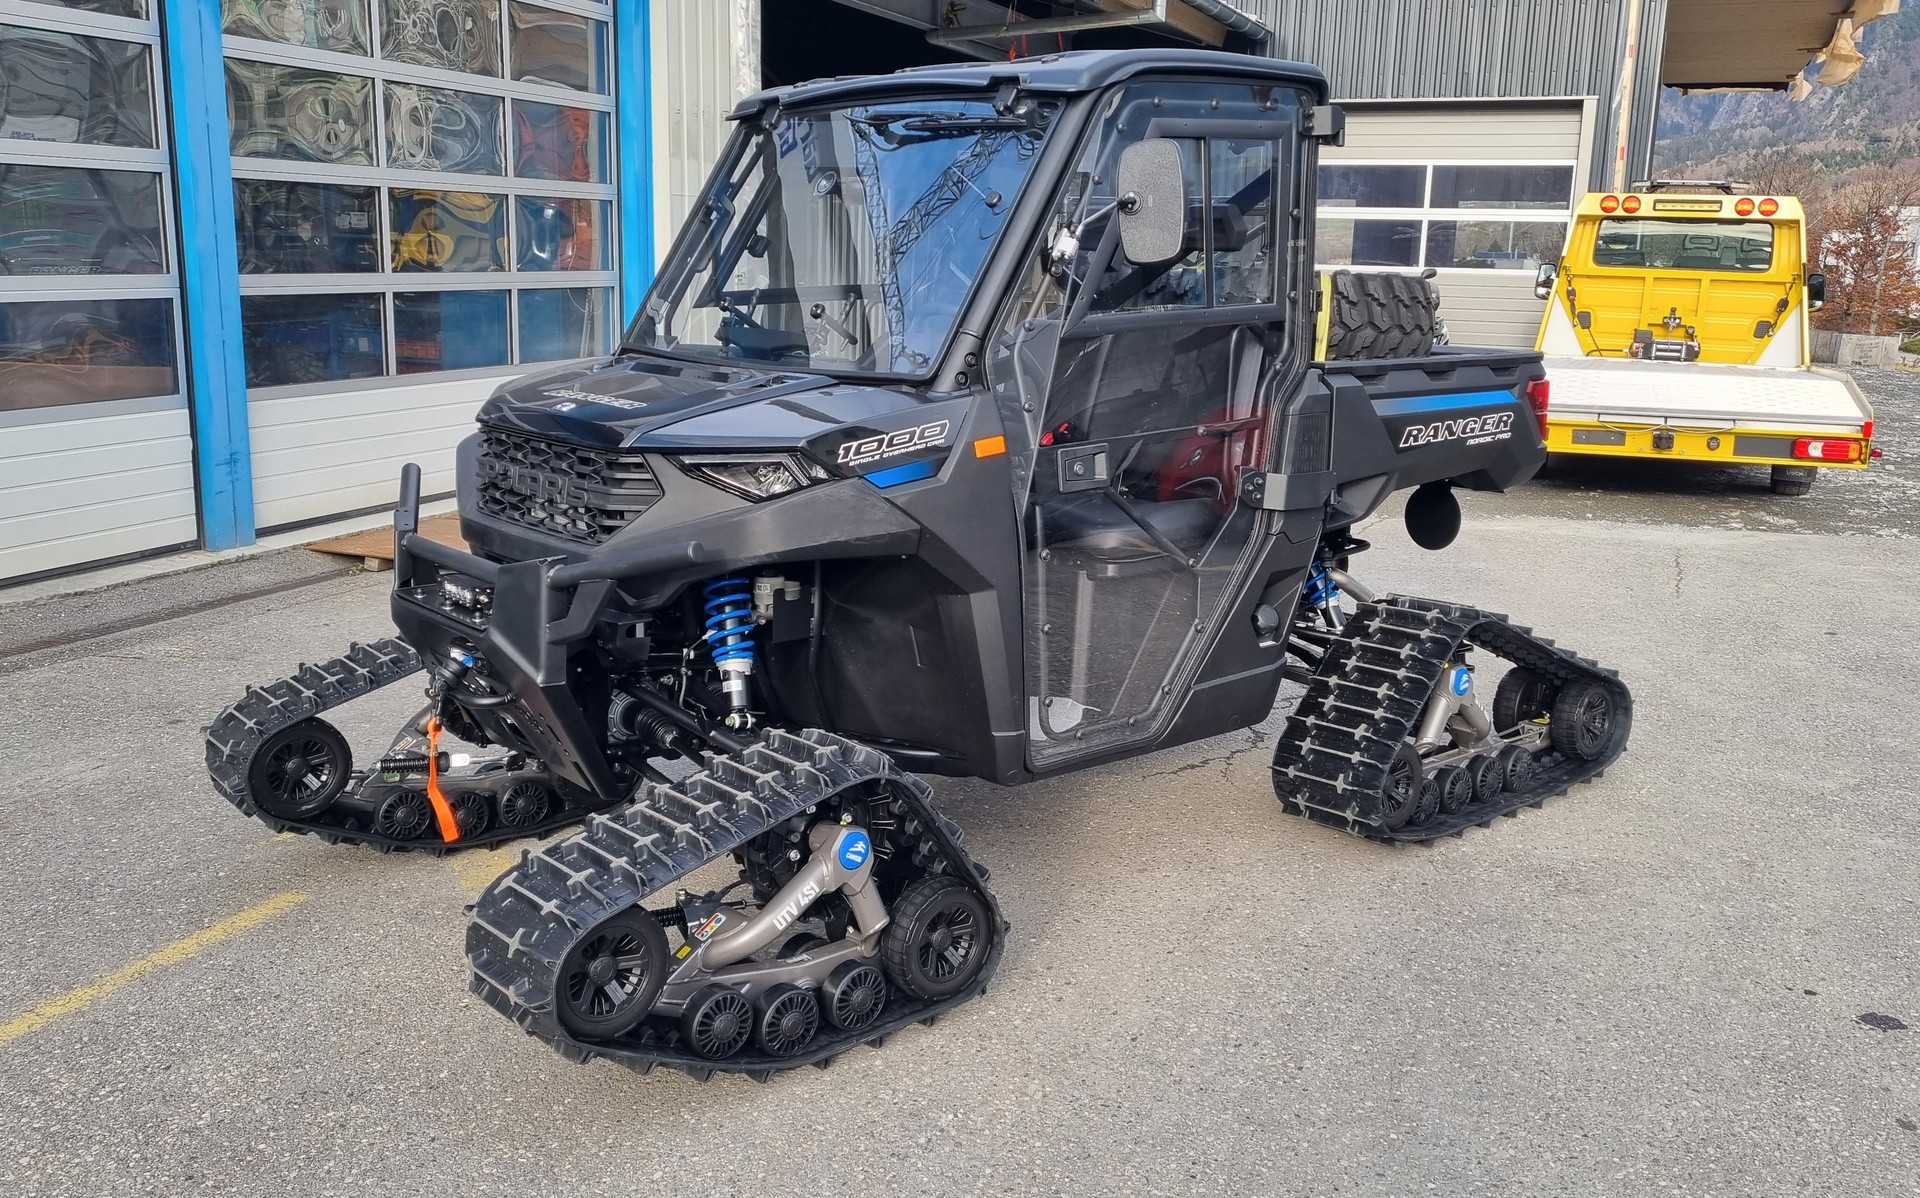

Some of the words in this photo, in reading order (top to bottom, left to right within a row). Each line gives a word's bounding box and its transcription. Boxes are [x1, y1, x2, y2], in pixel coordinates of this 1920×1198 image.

[837, 419, 950, 463] 1000
[1399, 412, 1514, 448] RANGER
[1466, 435, 1495, 445] NORDIC
[1494, 432, 1512, 441] PRO
[848, 454, 881, 467] SINGLE
[882, 443, 926, 458] OVERHEAD
[926, 439, 945, 447] CAM
[475, 456, 588, 507] POLARIS
[772, 902, 799, 931] UTV
